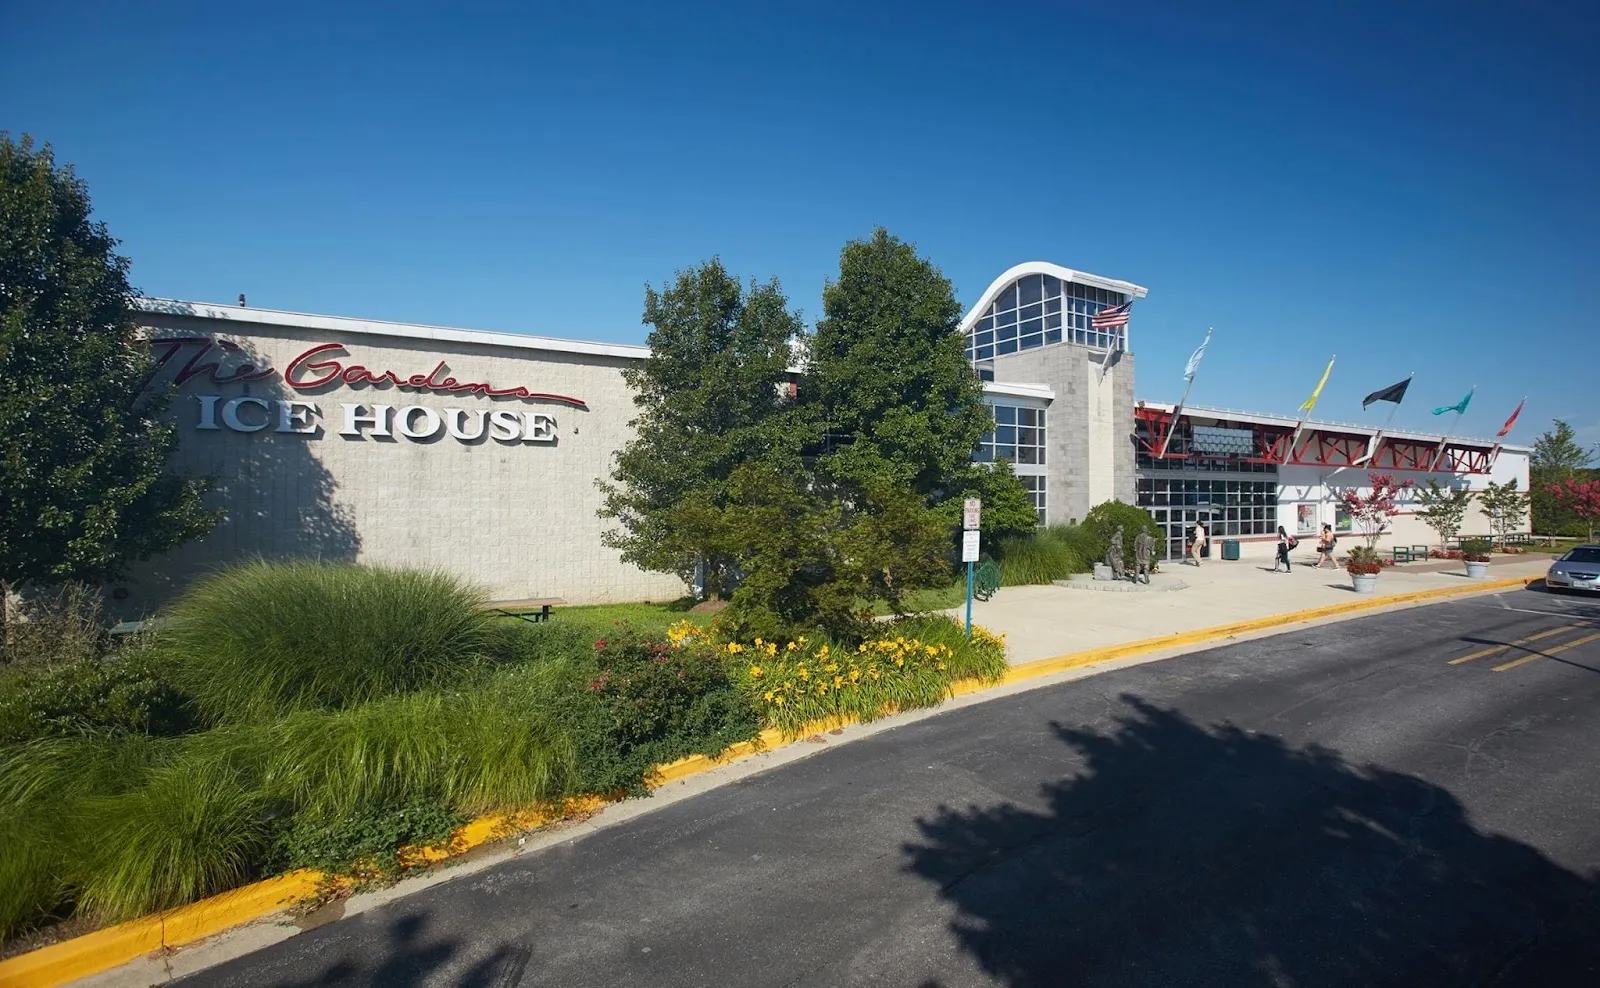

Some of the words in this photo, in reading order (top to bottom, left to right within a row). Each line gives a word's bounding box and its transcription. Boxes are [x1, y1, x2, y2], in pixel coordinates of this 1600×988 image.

[134, 337, 275, 406] The
[284, 343, 585, 406] Gardens
[195, 395, 318, 433] ICE
[339, 402, 558, 441] HOUSE
